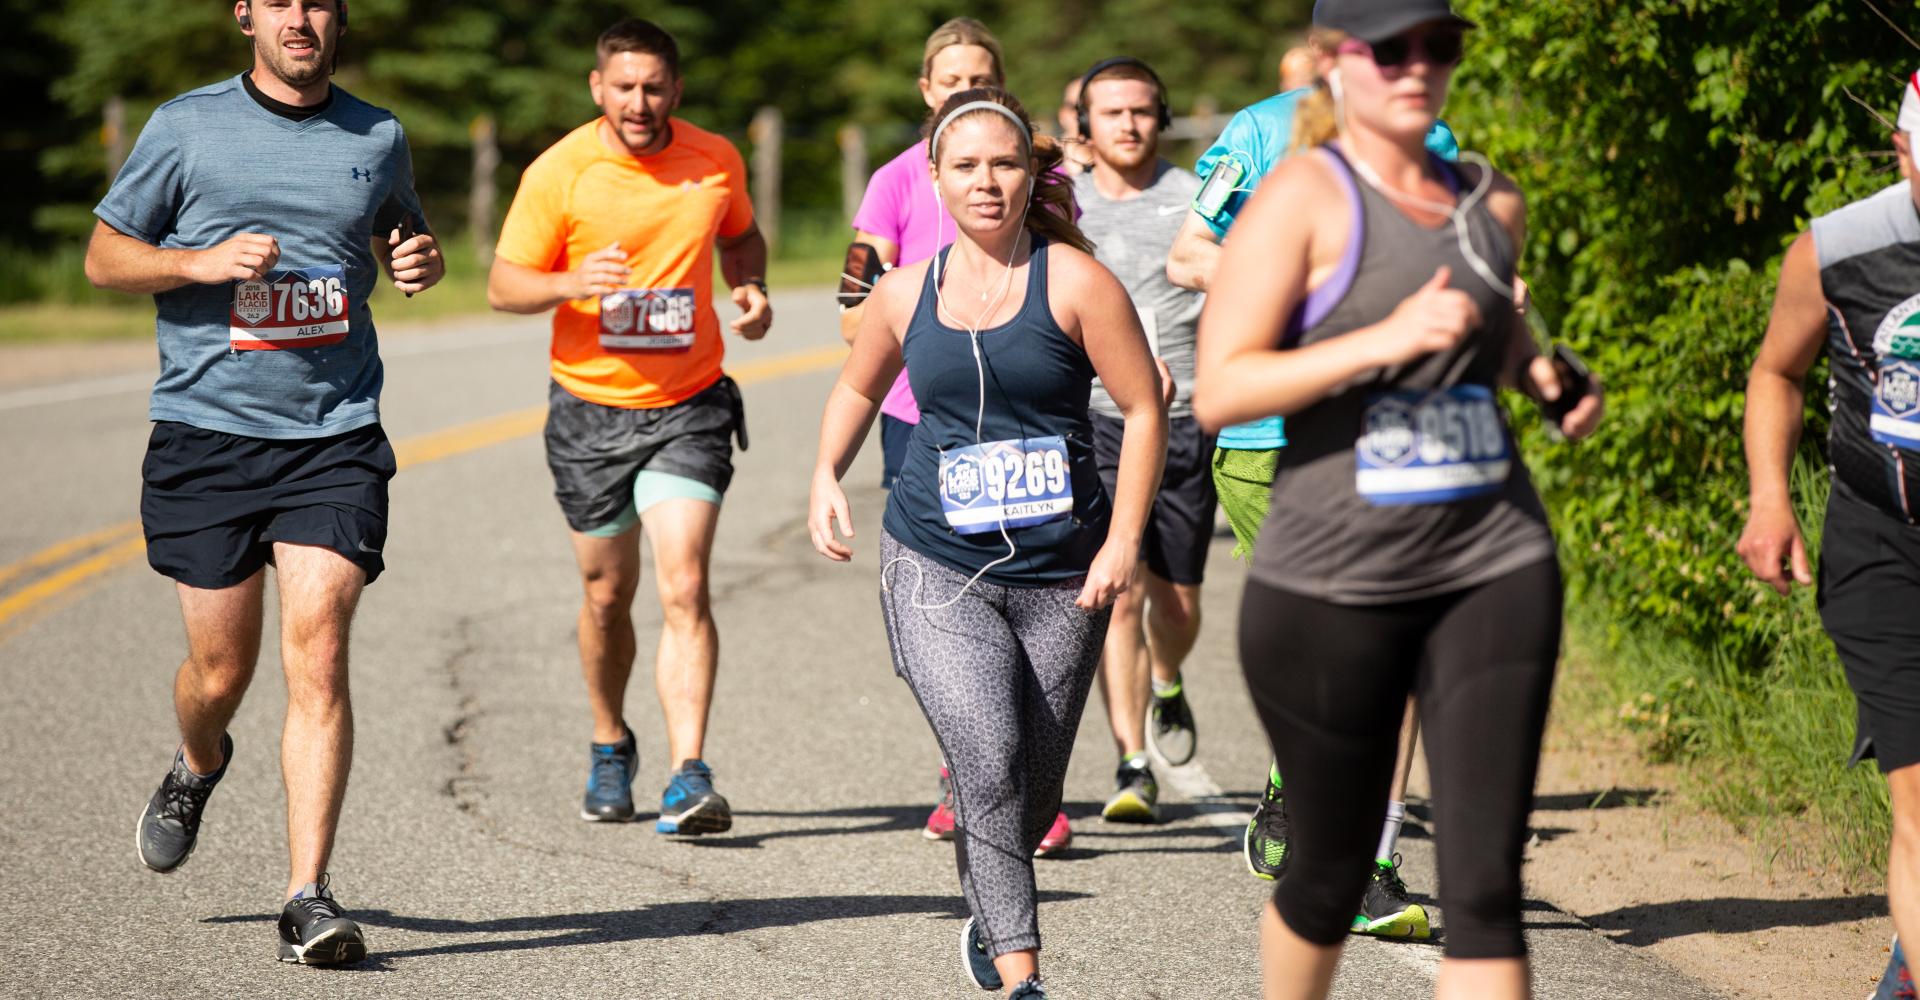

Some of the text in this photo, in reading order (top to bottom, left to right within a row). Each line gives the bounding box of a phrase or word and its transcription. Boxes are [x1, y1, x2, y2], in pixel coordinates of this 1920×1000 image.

[238, 291, 268, 300] LAKE
[274, 276, 343, 321] 7636
[238, 300, 268, 308] PLACID
[297, 325, 324, 337] ALEX
[984, 449, 1065, 501] 9269
[1003, 502, 1054, 516] KAITLYN
